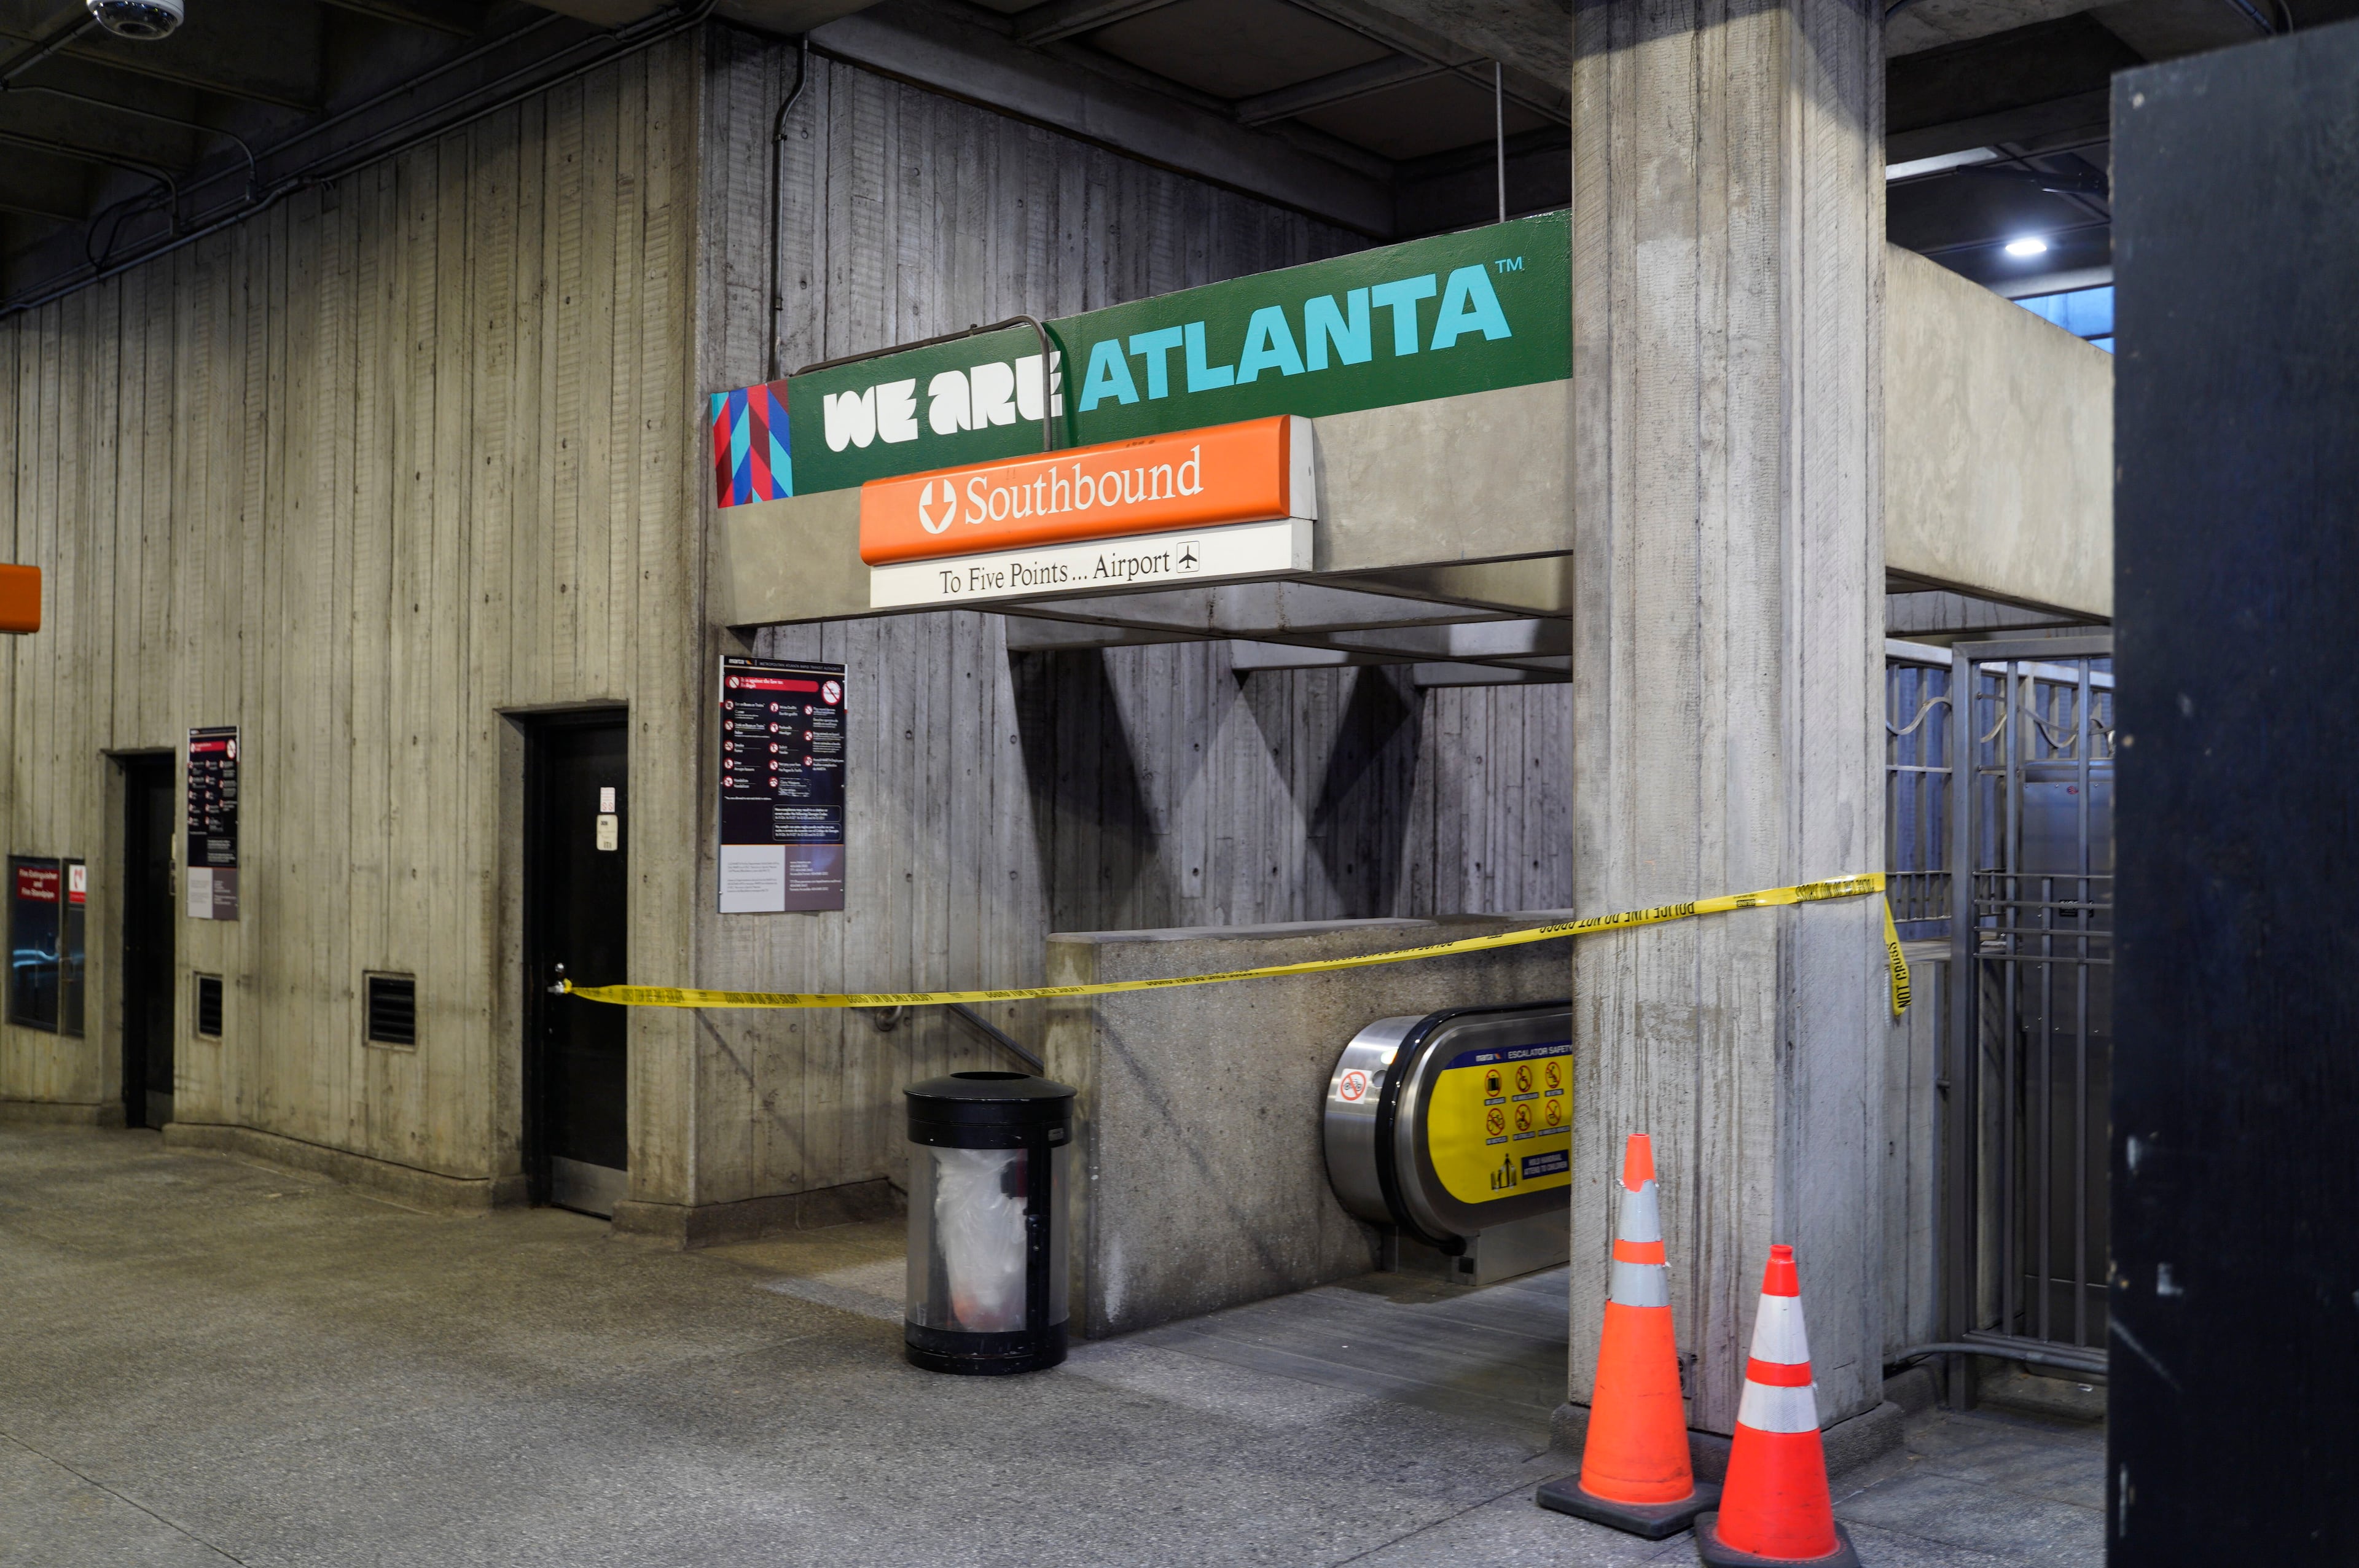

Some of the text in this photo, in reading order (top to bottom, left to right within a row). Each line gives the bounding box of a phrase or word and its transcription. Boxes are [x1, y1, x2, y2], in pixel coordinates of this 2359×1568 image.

[823, 378, 918, 453] WE
[928, 351, 1063, 435] ARE
[1078, 263, 1512, 413] ATLANTA
[964, 445, 1204, 525] Southbound
[939, 571, 961, 594] To
[968, 567, 1004, 591] Five
[1092, 550, 1170, 581] Airport
[1886, 941, 1911, 1009] NOT CROSS
[1508, 1047, 1548, 1059] ESCALATOR
